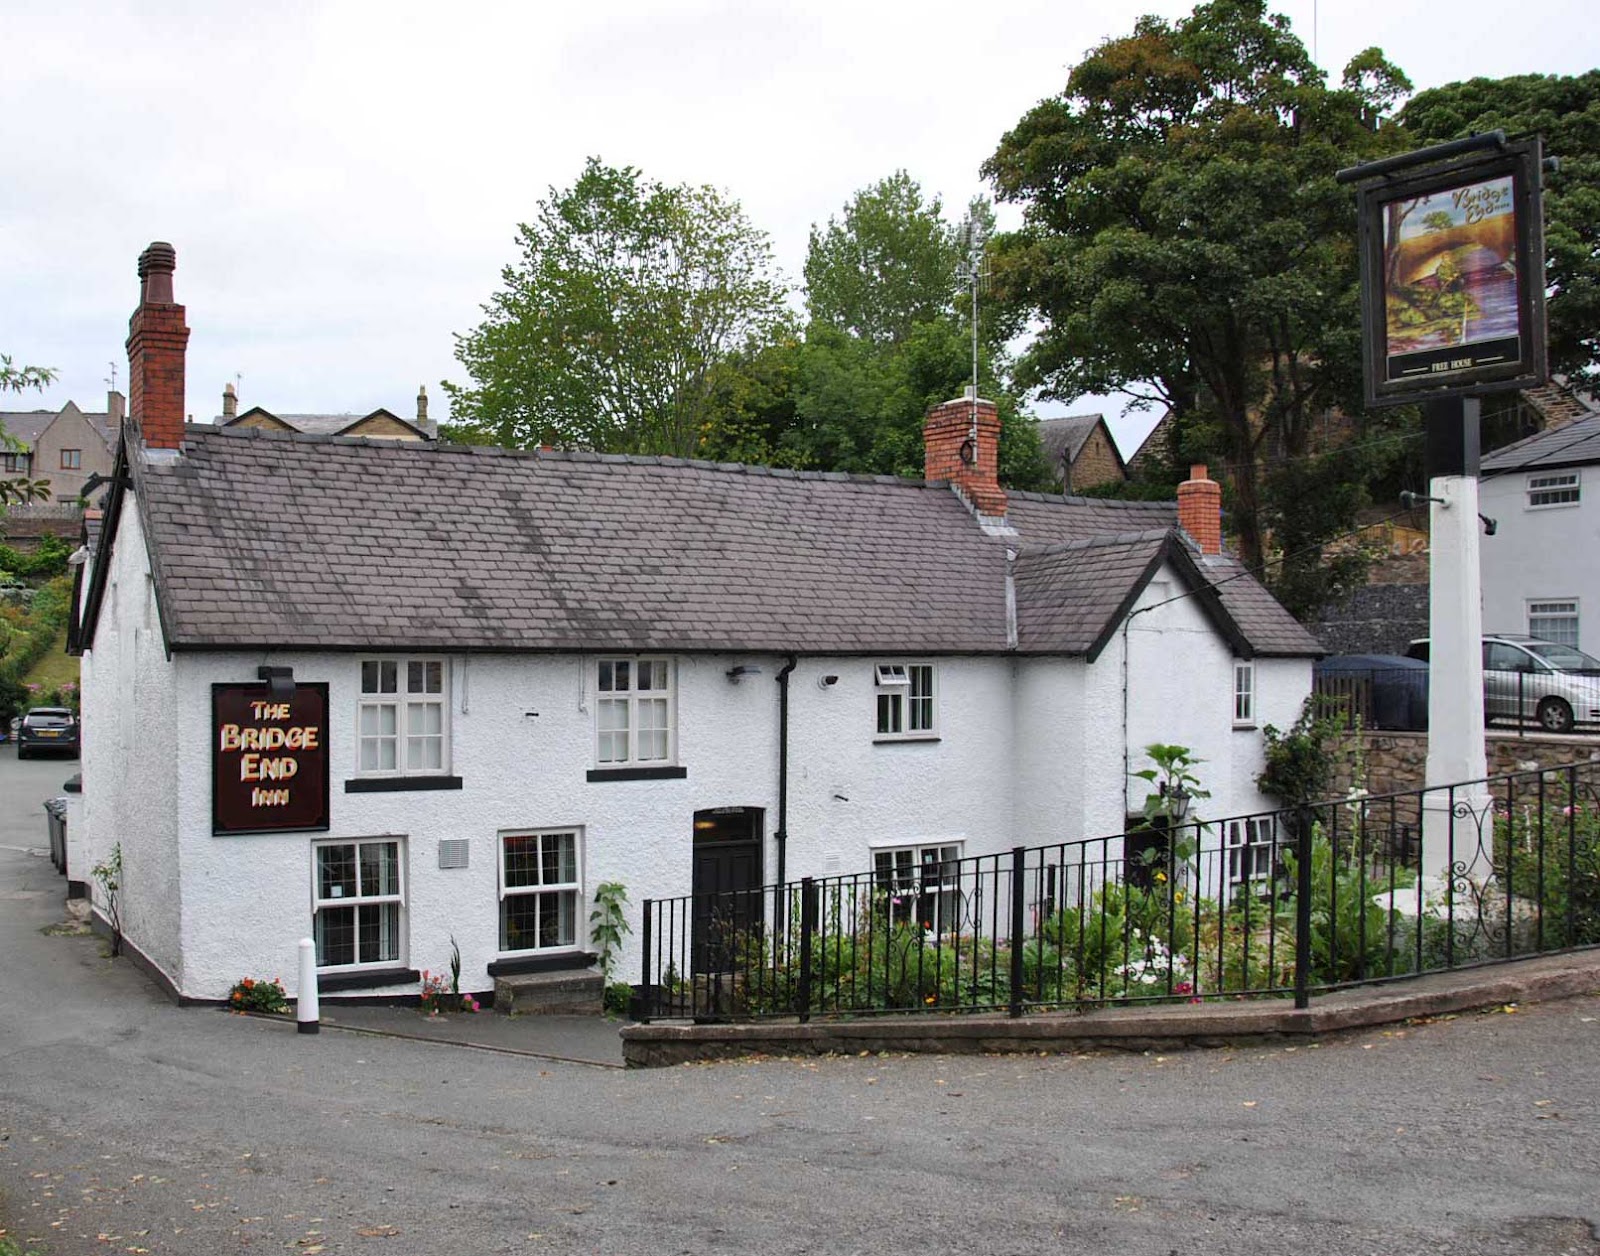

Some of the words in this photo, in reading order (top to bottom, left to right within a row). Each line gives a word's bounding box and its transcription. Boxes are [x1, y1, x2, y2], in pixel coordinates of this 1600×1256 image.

[1431, 361, 1449, 372] FREE
[1450, 358, 1472, 369] HOUSE
[250, 701, 291, 720] THE
[220, 724, 319, 751] BRIDGE
[240, 753, 298, 782] END
[252, 787, 290, 807] INN
